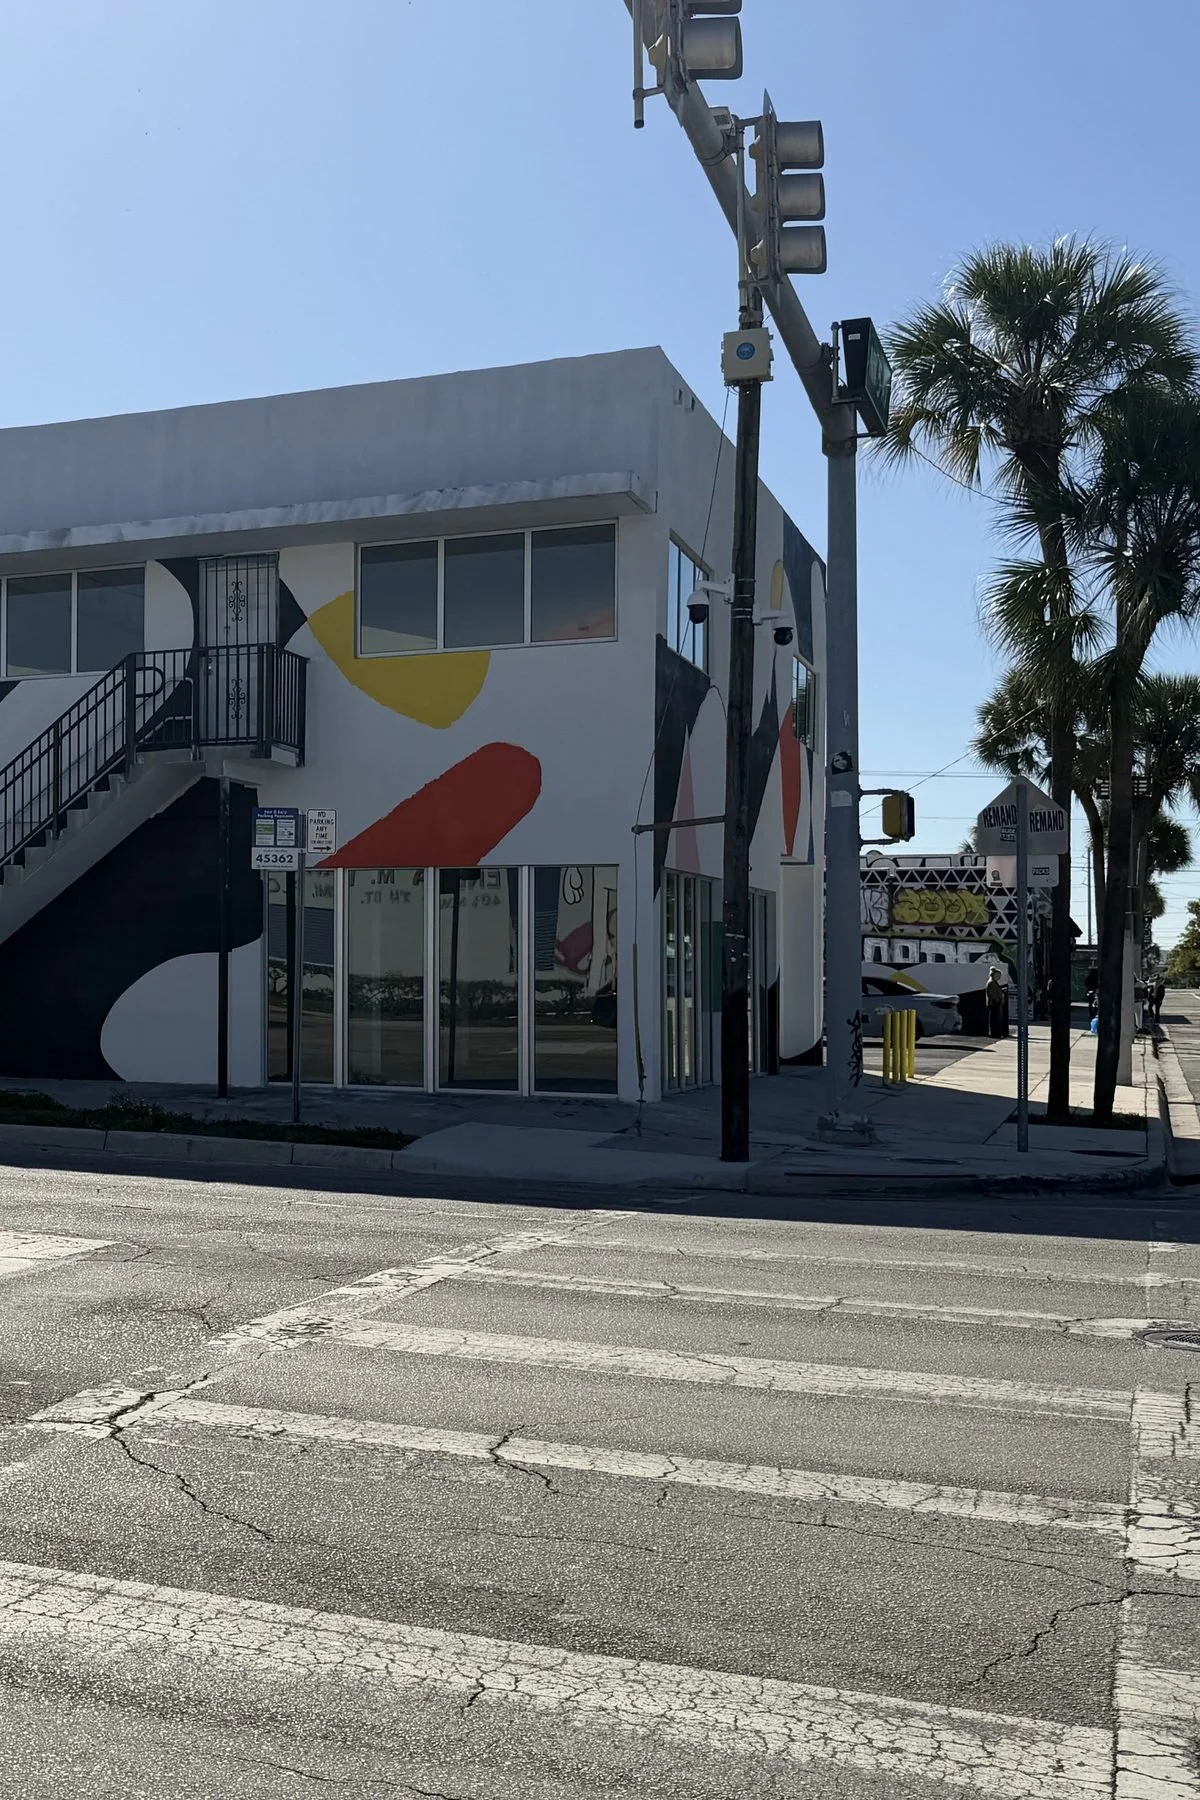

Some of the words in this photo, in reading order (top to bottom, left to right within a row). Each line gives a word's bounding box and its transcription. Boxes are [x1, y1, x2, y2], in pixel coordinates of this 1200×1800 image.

[982, 805, 1017, 828] REMAND
[1029, 810, 1064, 833] REMAND
[255, 854, 294, 864] 45362
